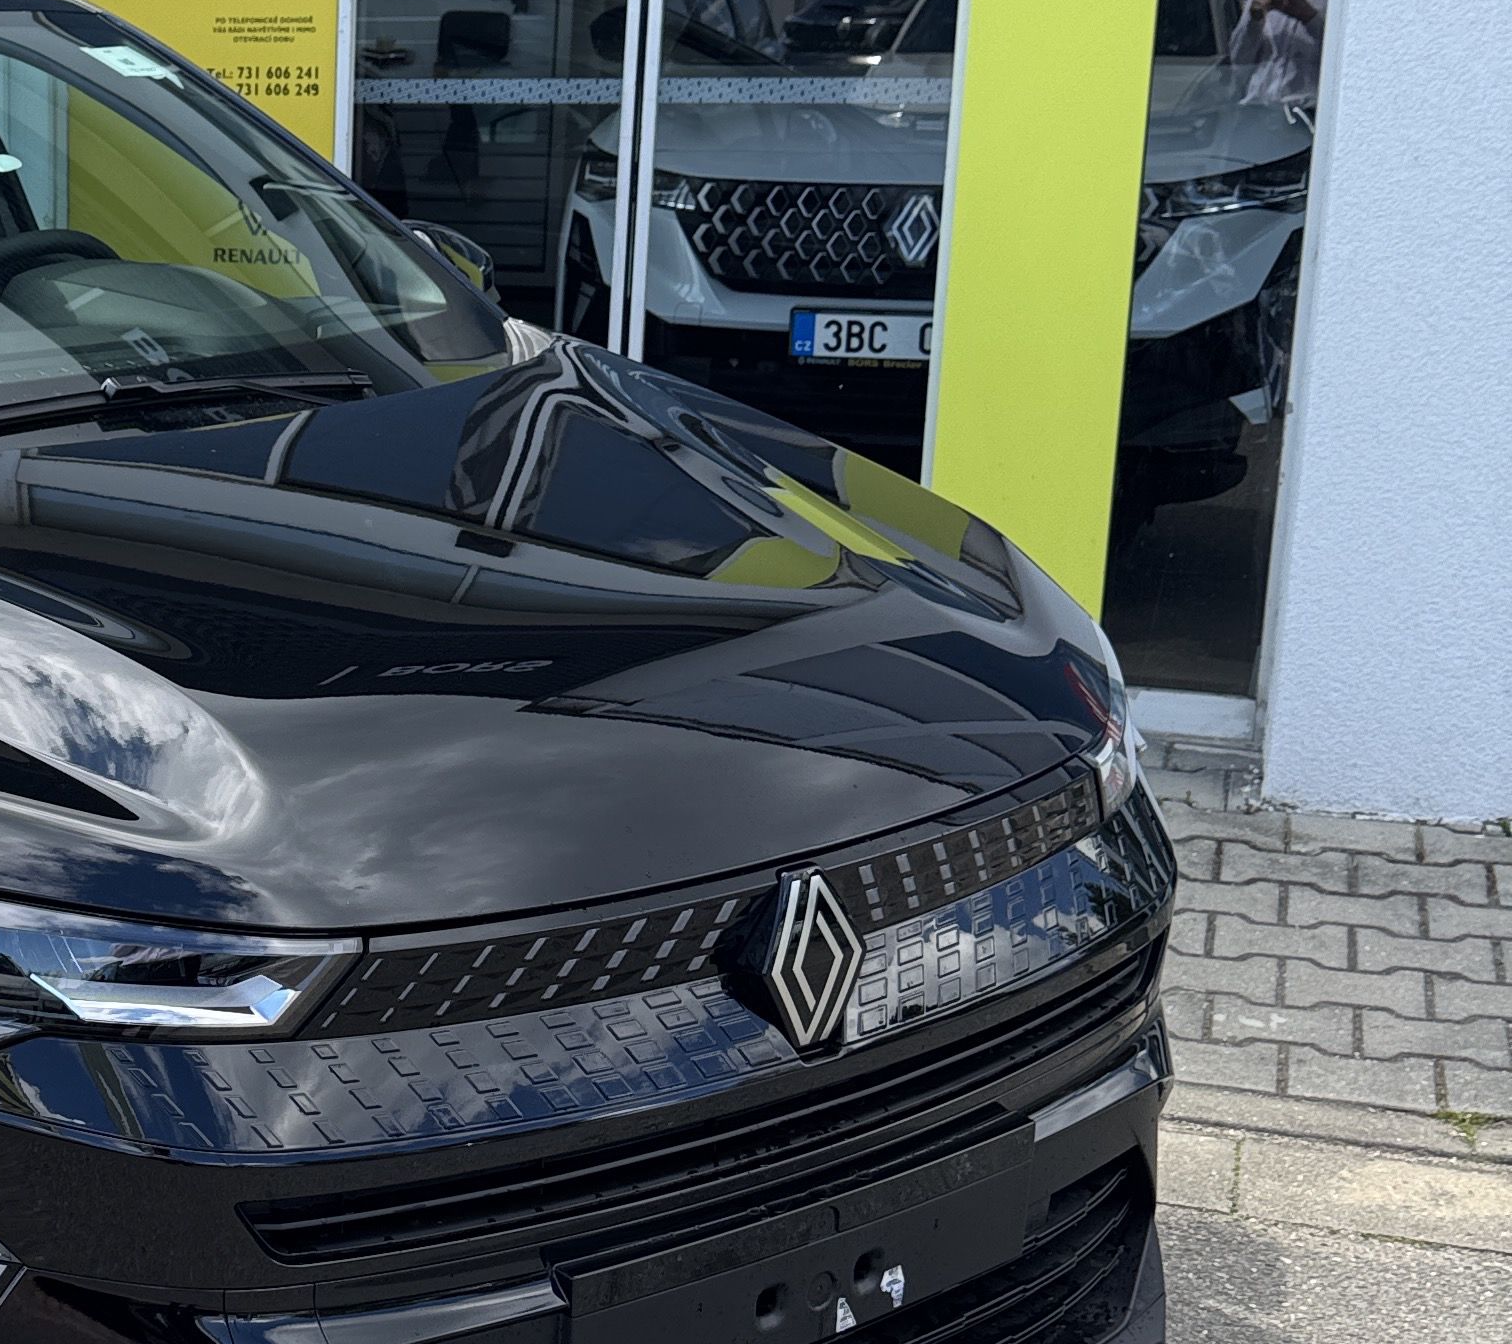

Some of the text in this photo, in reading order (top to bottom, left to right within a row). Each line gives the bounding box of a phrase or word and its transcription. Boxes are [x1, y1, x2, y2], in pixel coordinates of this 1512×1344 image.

[237, 66, 260, 80] 731
[266, 66, 291, 80] 606
[296, 66, 320, 80] 241
[236, 83, 259, 96] 731
[265, 83, 290, 96] 606
[213, 247, 301, 265] RENAULT
[823, 320, 888, 354] 3BC
[794, 341, 811, 351] CZ
